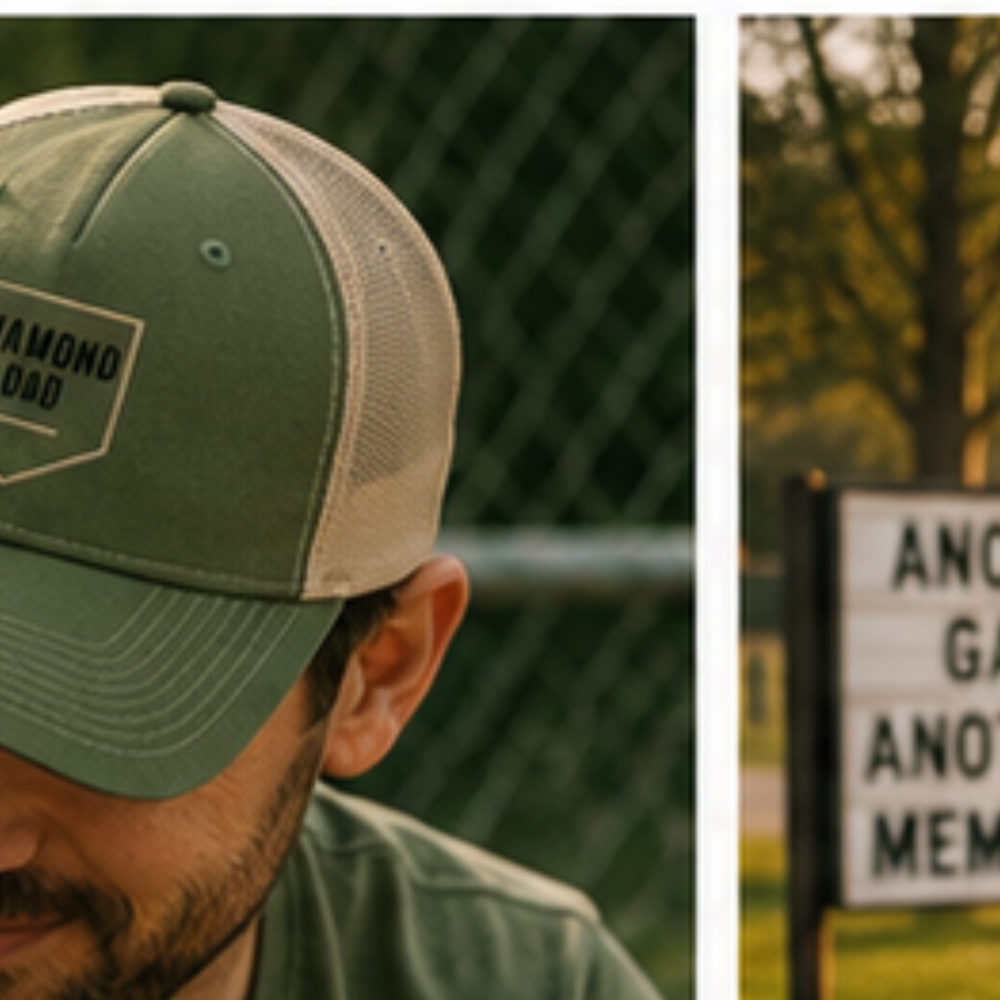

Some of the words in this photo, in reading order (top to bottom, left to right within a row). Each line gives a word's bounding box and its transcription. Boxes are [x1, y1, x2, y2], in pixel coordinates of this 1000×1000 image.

[1, 363, 64, 411] DAD
[944, 616, 1000, 682] G
[865, 713, 1000, 782] ANO
[873, 809, 1000, 878] MEM
